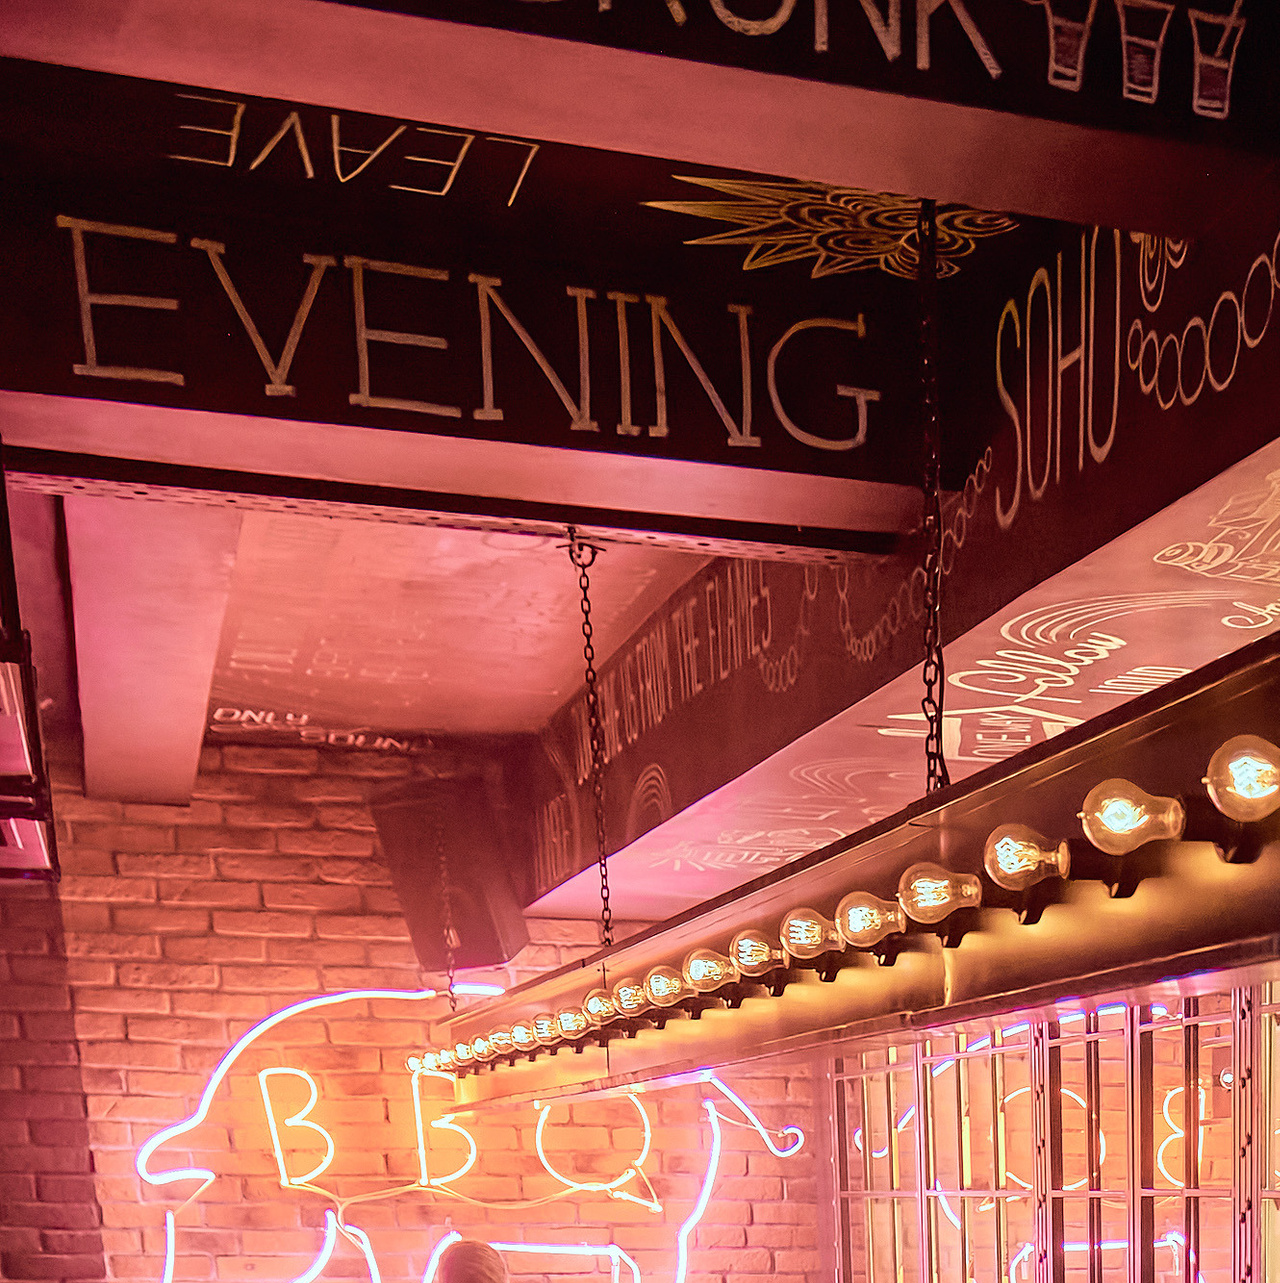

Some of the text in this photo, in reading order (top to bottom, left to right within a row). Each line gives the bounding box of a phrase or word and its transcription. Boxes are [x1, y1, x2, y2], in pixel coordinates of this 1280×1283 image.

[172, 93, 541, 207] LEAVE
[56, 214, 881, 450] EVENING
[635, 617, 674, 732] FROM
[671, 597, 704, 703] THE
[705, 558, 773, 686] FLAMES
[971, 711, 1034, 759] ONE WAY
[258, 1066, 664, 1213] BBQ
